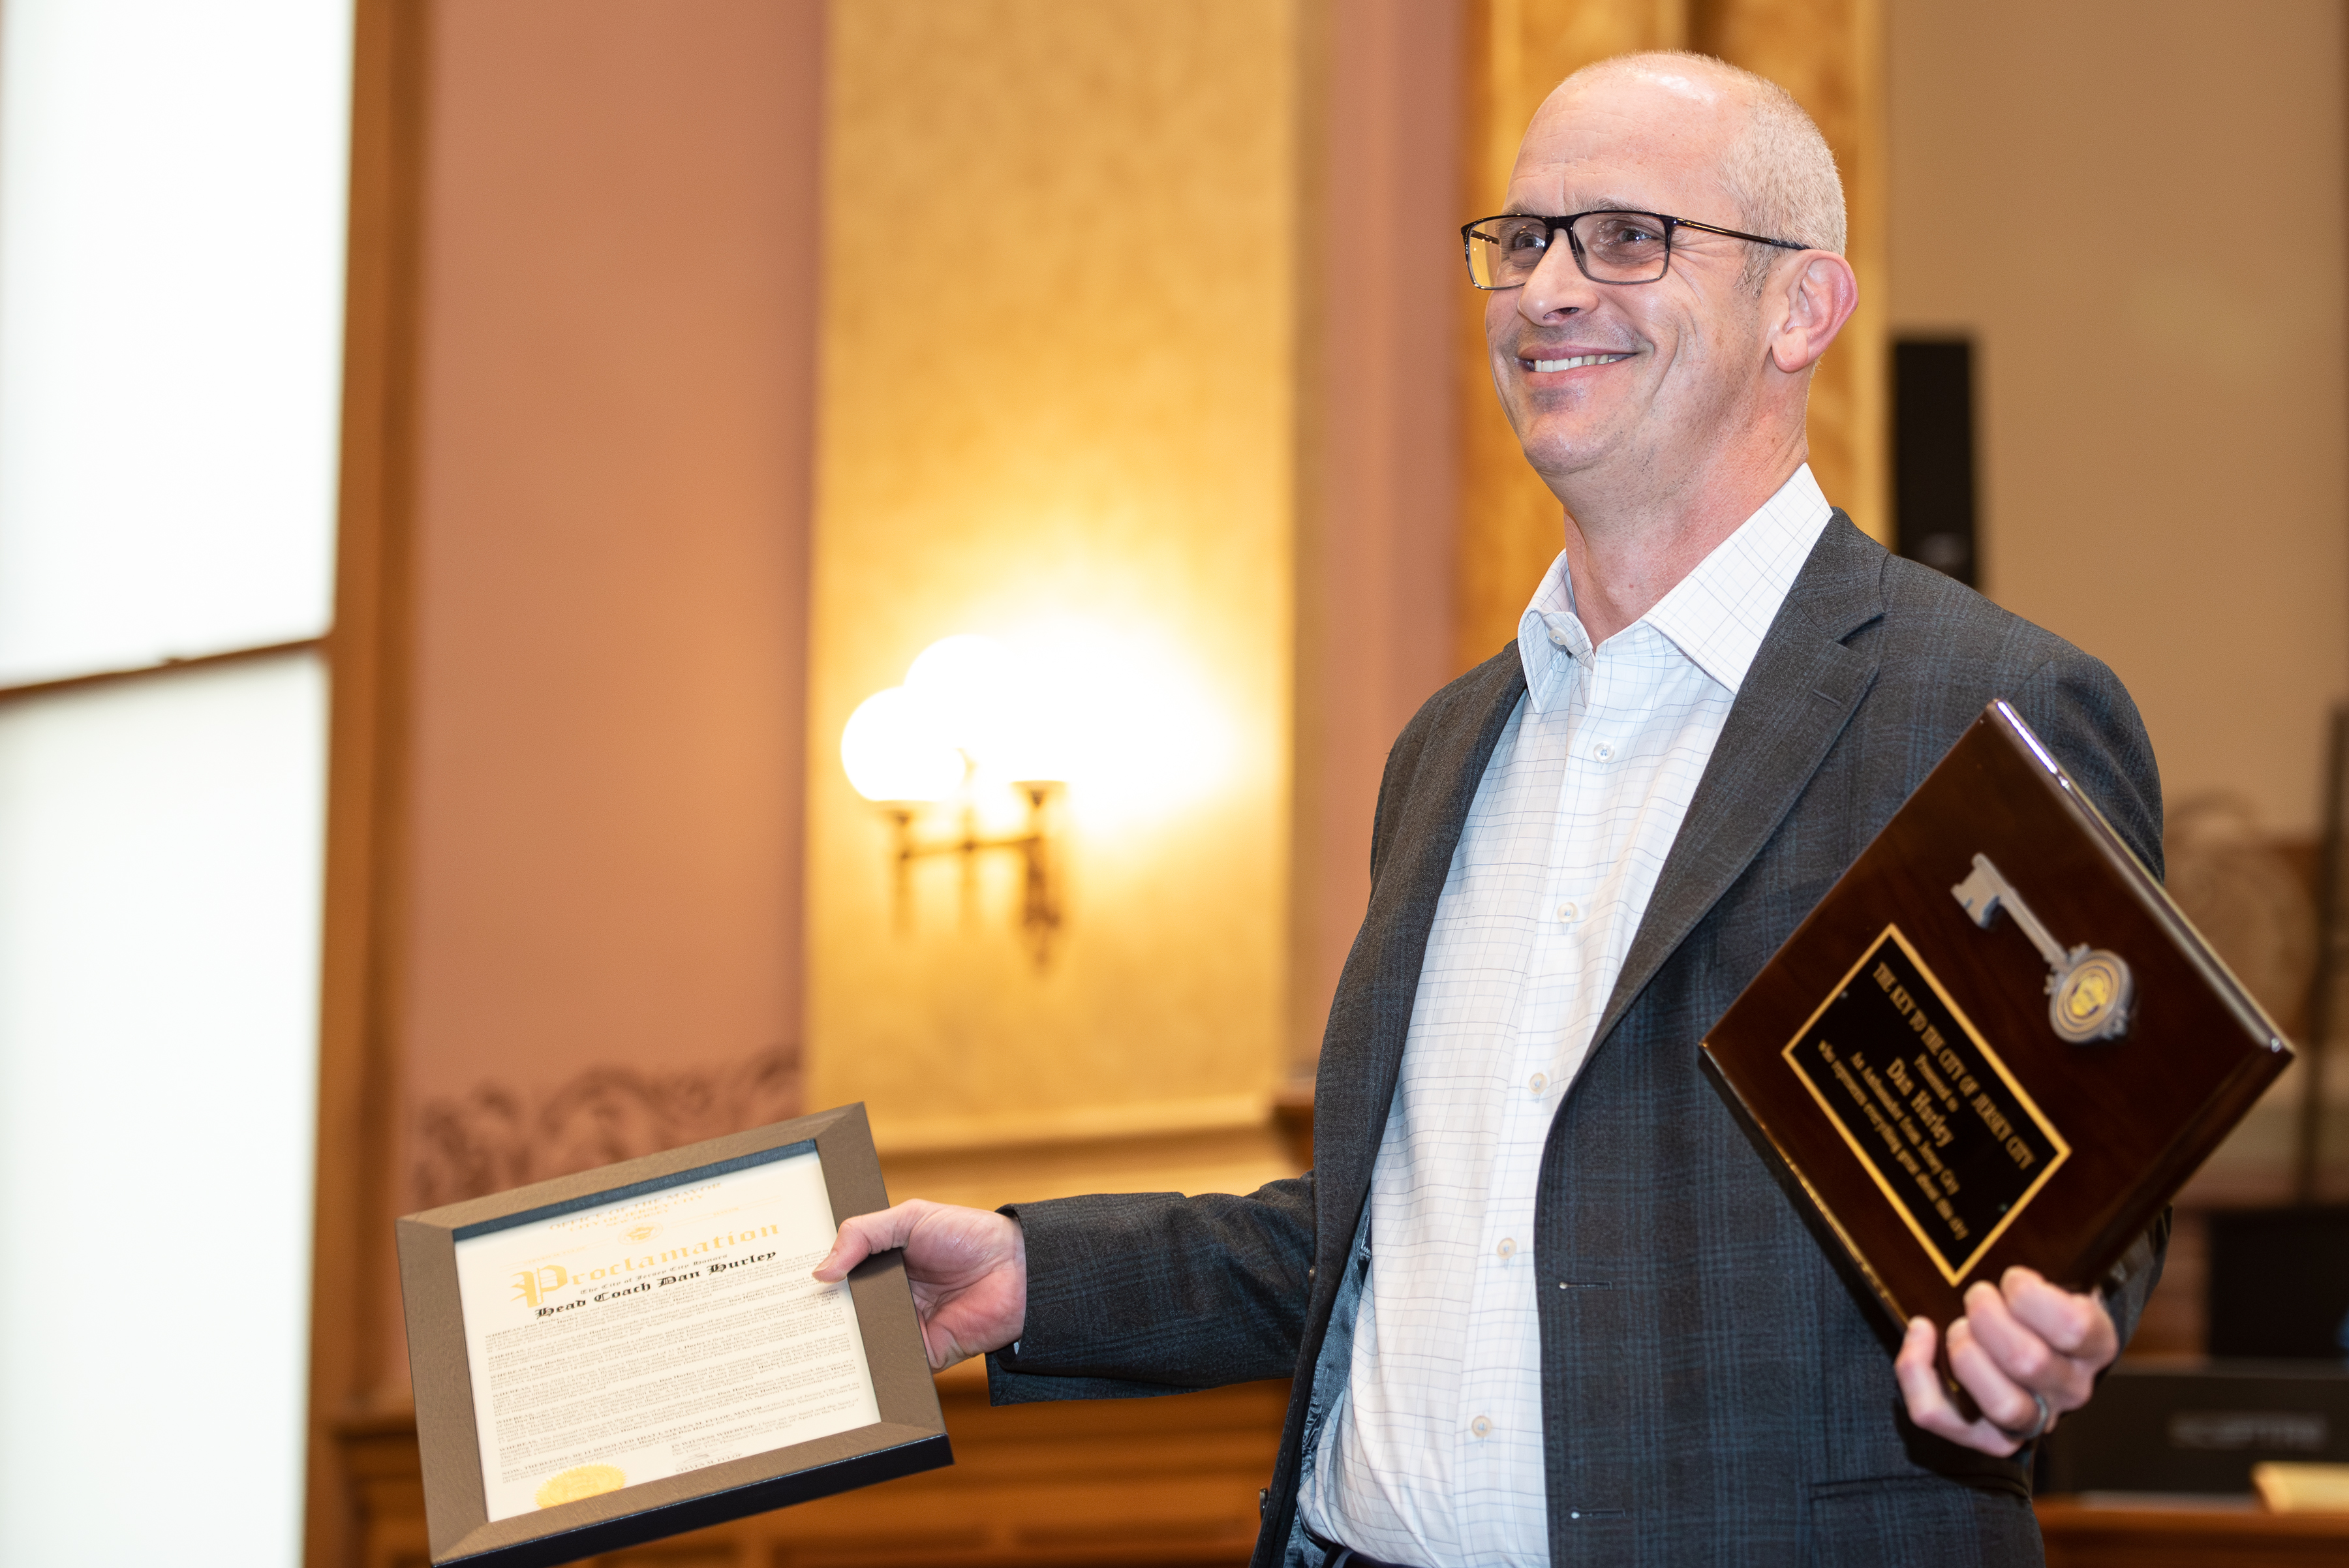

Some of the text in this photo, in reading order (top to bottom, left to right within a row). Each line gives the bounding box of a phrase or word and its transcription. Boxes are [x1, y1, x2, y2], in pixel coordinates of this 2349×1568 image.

[1873, 961, 1896, 992] THE
[1889, 985, 1916, 1015] KEY
[1909, 1009, 1927, 1031] TO
[1921, 1024, 1944, 1055] THE
[1938, 1048, 1966, 1080] CITY
[2006, 1135, 2034, 1169] CITY
[1886, 1058, 1953, 1146] Dan Hurley
[549, 1182, 722, 1230] OFFICE OF THE MAYOR
[570, 1193, 703, 1231] CITY OF JERSEY CITY
[633, 1209, 668, 1220] JERSEY
[510, 1224, 778, 1308] Proclamation
[536, 1252, 776, 1319] Head Coach Dan Hurley
[637, 1270, 666, 1280] Jersey
[693, 1254, 727, 1265] Honors
